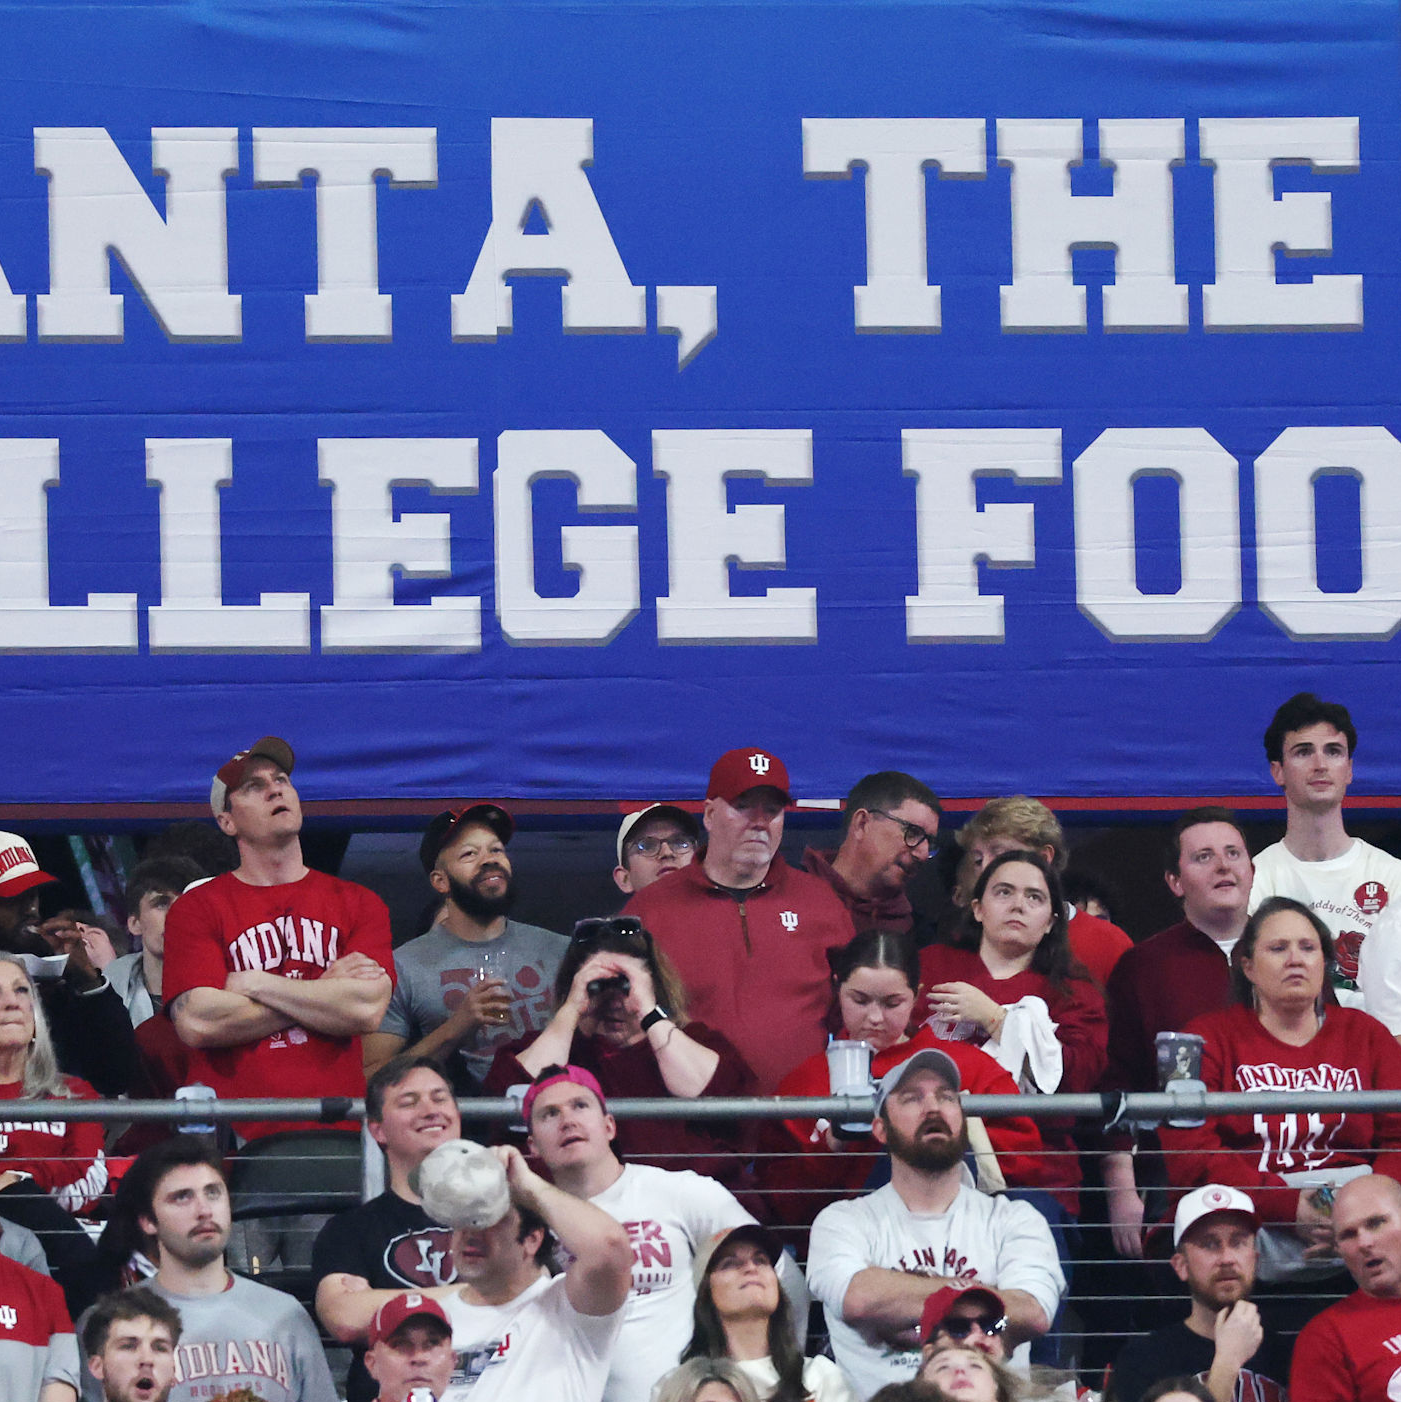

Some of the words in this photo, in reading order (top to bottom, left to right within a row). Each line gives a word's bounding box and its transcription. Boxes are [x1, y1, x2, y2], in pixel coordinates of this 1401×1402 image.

[802, 117, 1365, 330] THE
[227, 915, 339, 973] INDIANA
[1235, 1063, 1363, 1093] INDIANA
[171, 1339, 291, 1388] NDIANA
